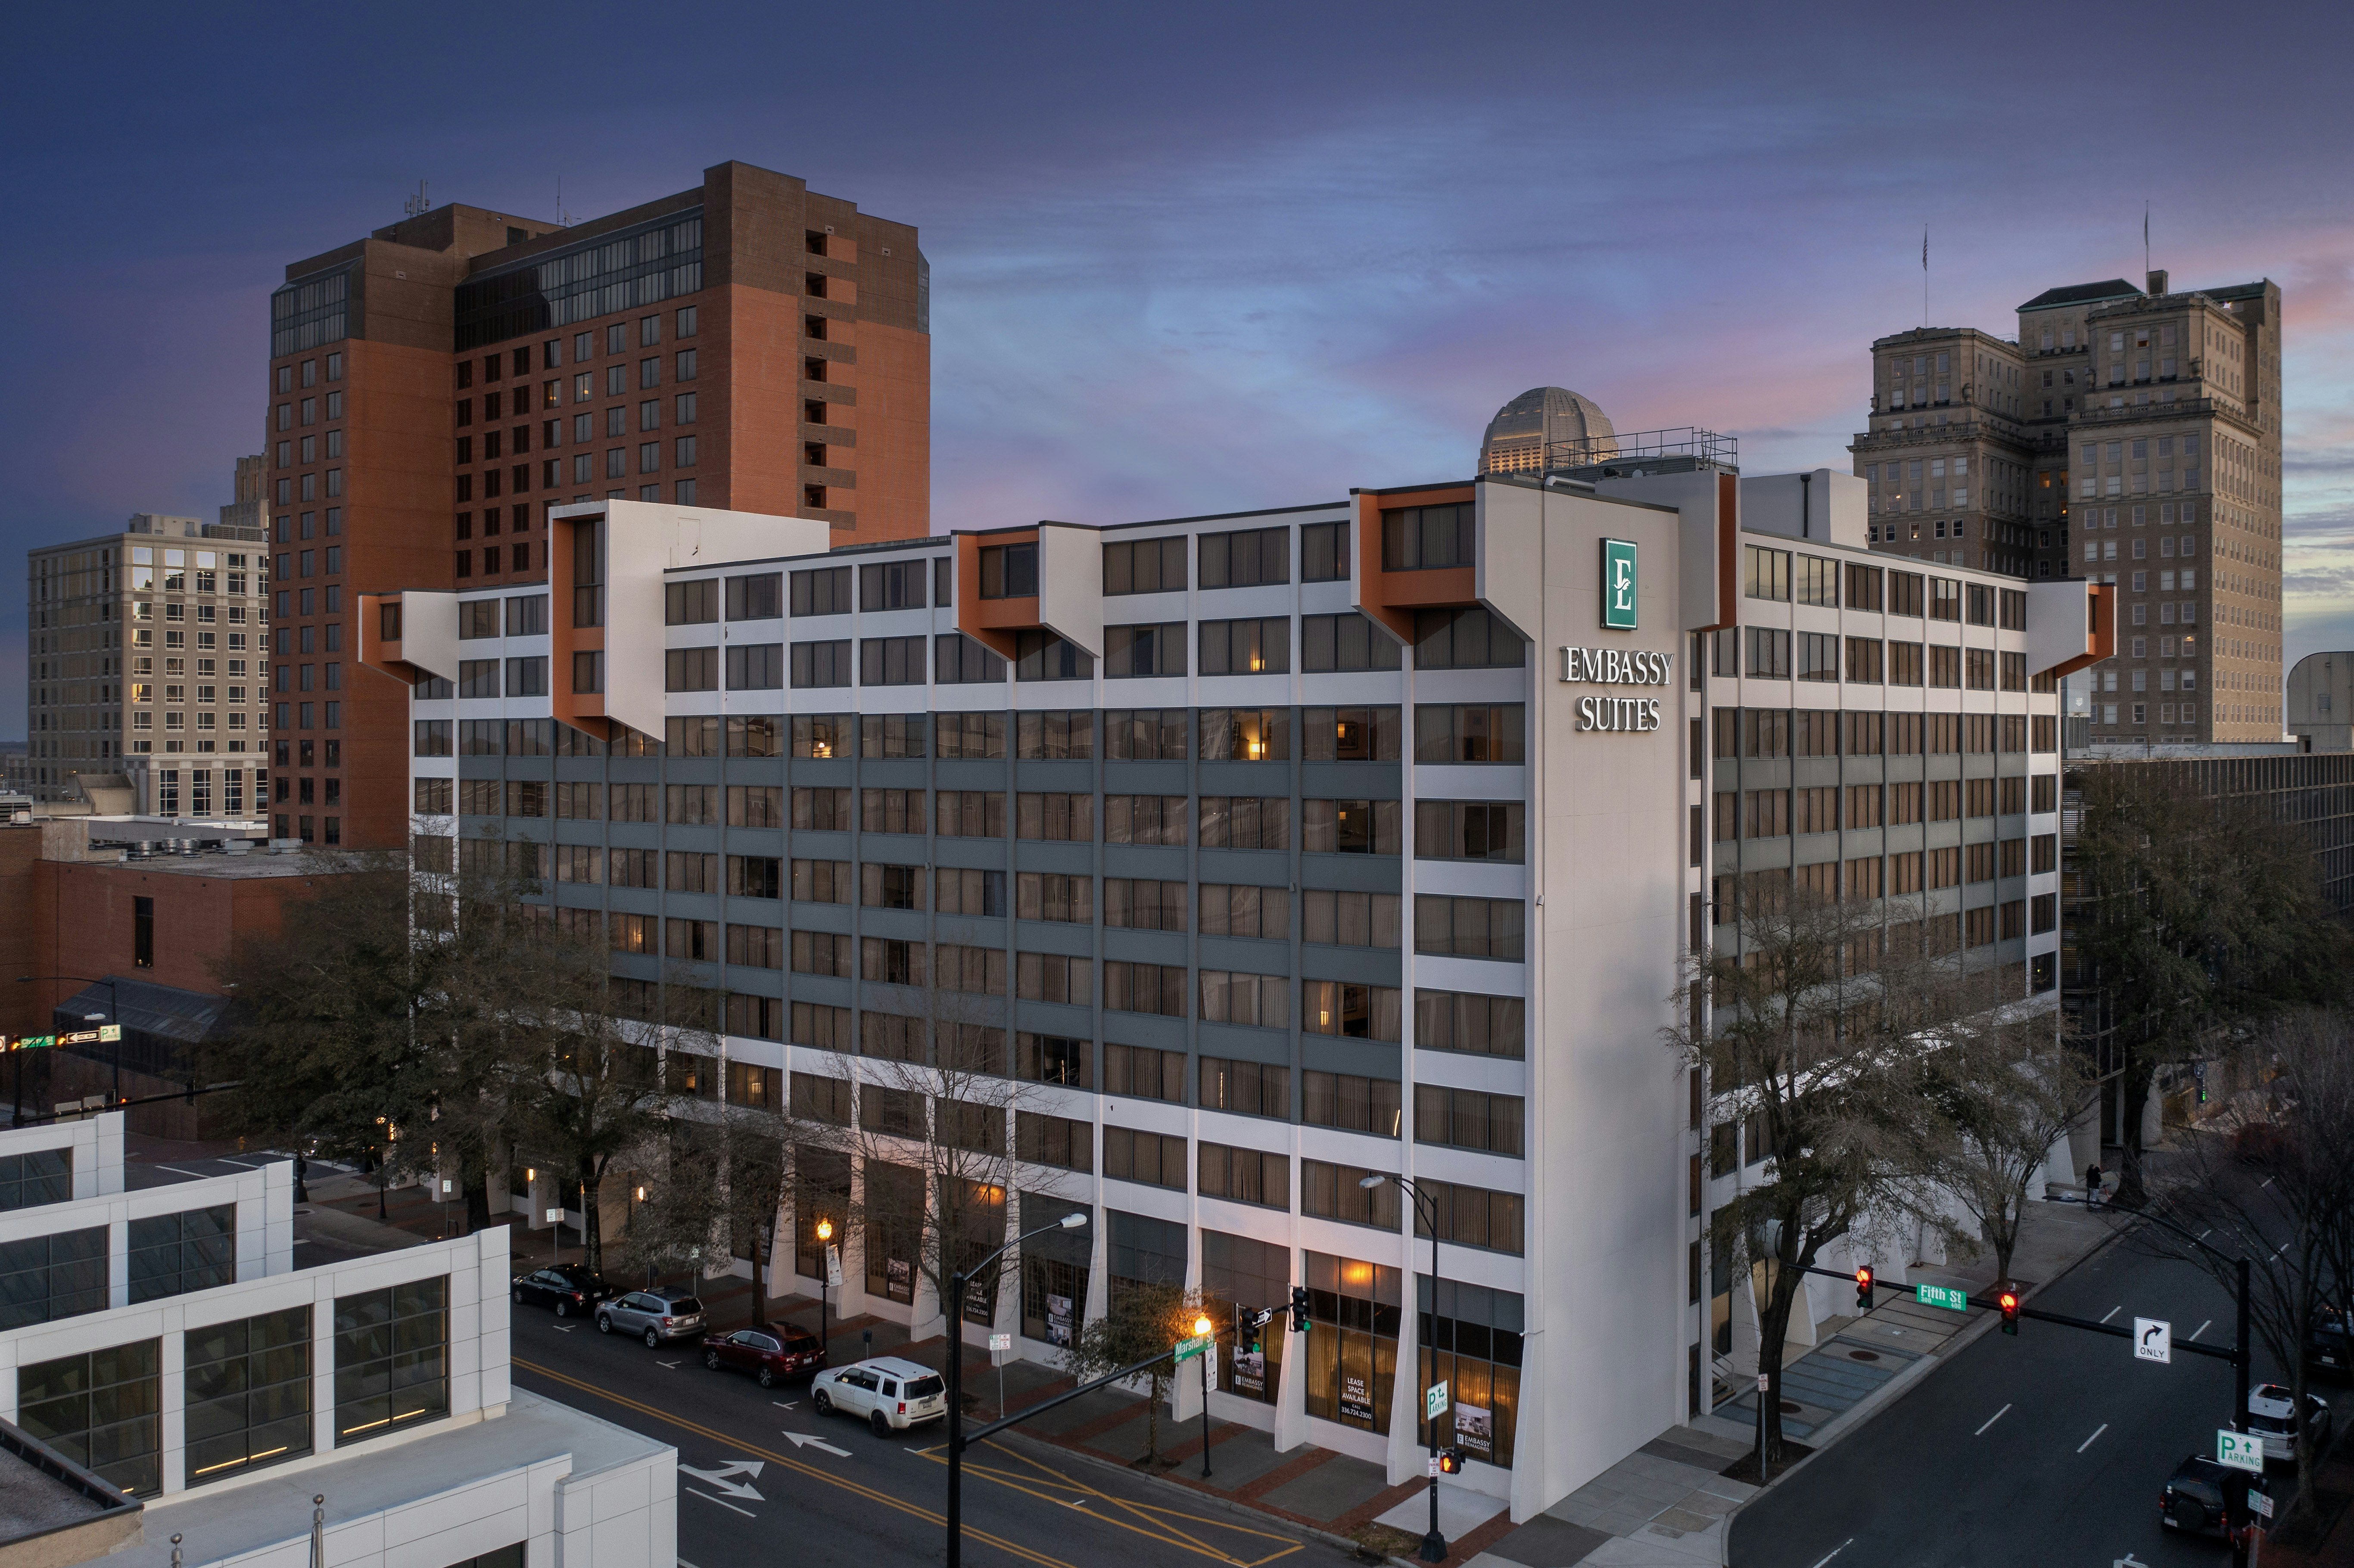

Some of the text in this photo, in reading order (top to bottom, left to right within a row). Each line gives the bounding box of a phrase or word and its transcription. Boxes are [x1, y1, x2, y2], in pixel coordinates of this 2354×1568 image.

[1566, 647, 1675, 685] EMBASSY
[1581, 697, 1661, 731] SUITES
[1921, 1285, 1961, 1304] Fifth St
[1176, 1330, 1214, 1356] Marshall St
[2140, 1347, 2164, 1358] ONLY
[1242, 1376, 1263, 1387] EMBASSY
[1348, 1377, 1364, 1387] LEASE
[1348, 1385, 1365, 1395] SPACE
[1342, 1392, 1370, 1405] AVAILABLE
[1429, 1392, 1447, 1415] PARKING
[1341, 1406, 1371, 1419] 336.724.2300
[1465, 1435, 1490, 1447] EMBASSY
[1465, 1441, 1490, 1452] REIMAGINED
[2221, 1435, 2260, 1466] PARKING
